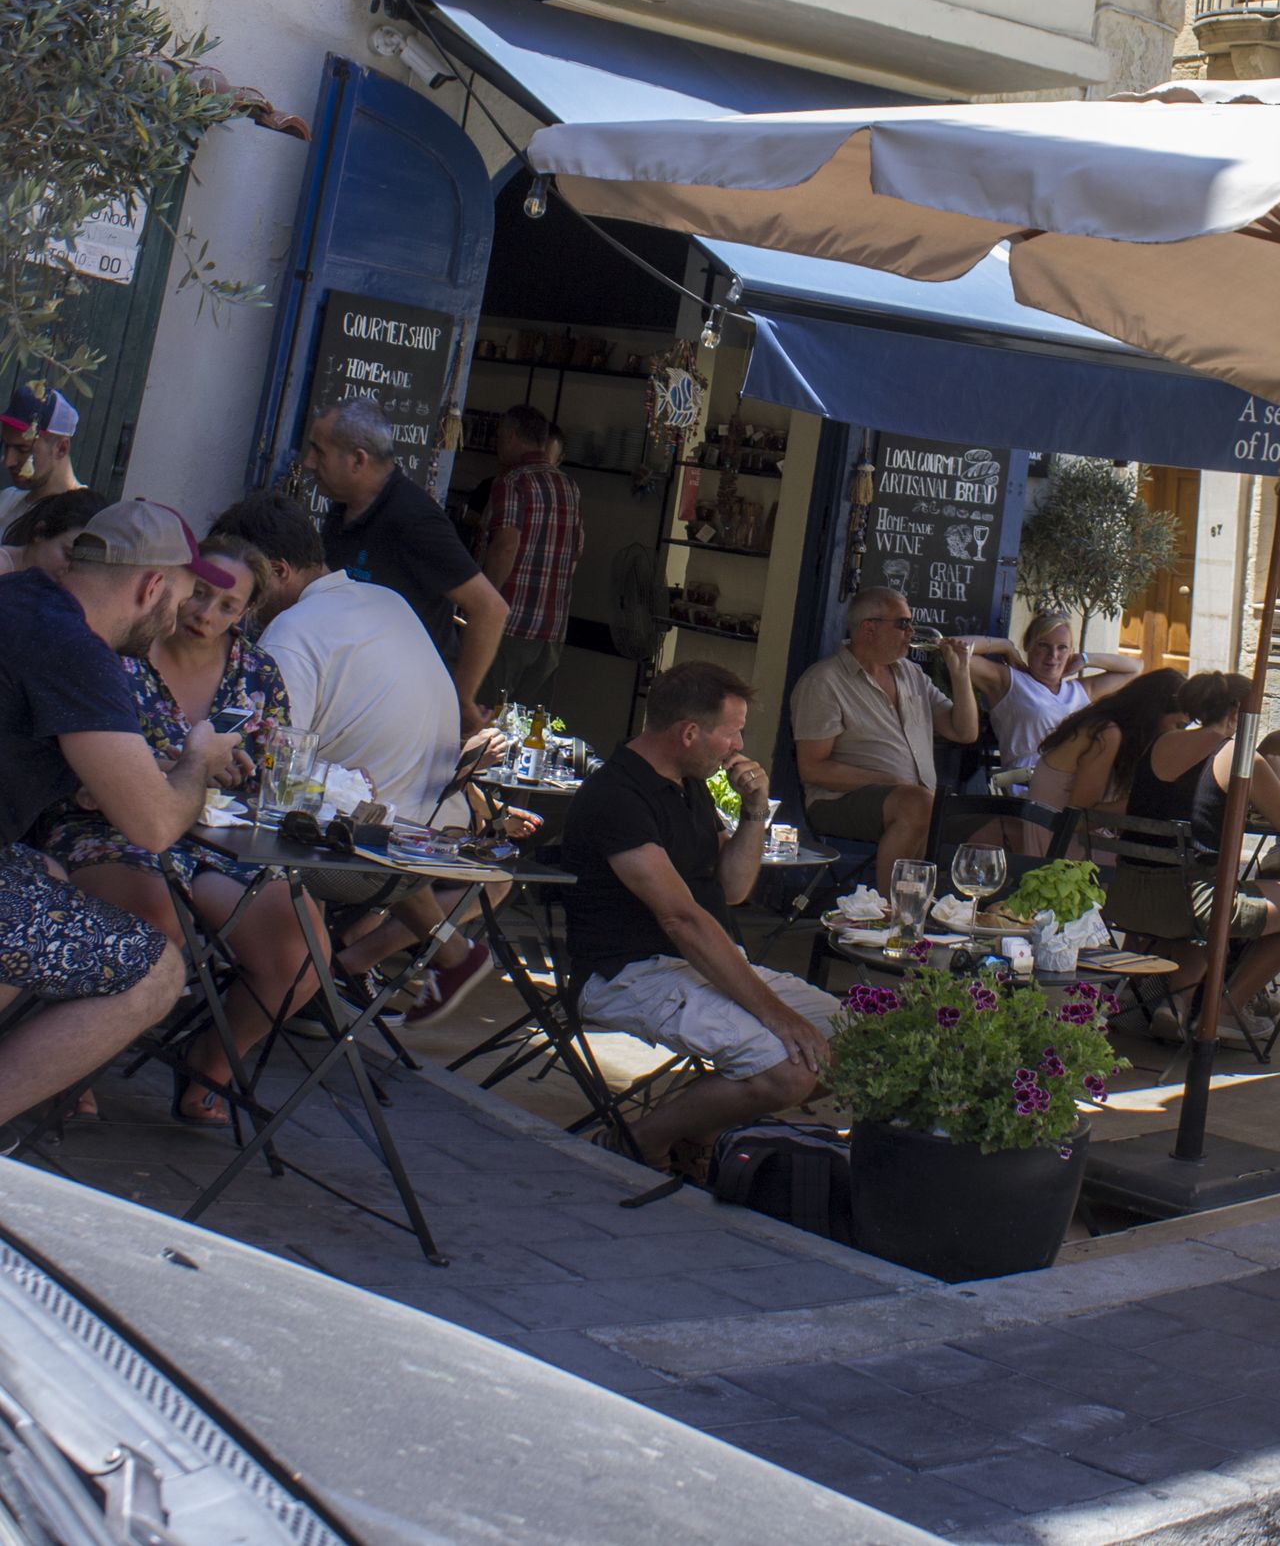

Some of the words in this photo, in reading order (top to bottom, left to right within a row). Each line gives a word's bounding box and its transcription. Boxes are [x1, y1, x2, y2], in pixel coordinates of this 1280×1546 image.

[343, 312, 407, 346] GOURMET
[404, 326, 441, 351] SHOP
[1238, 396, 1257, 423] A
[1234, 431, 1261, 461] of
[885, 447, 917, 471] LOCAL
[917, 451, 963, 477] GOURMET
[879, 471, 951, 500] ARTISANAL
[954, 480, 998, 504] BREAD
[875, 532, 924, 556] WINE
[929, 561, 974, 585] CRAFT
[928, 580, 968, 602] BEER
